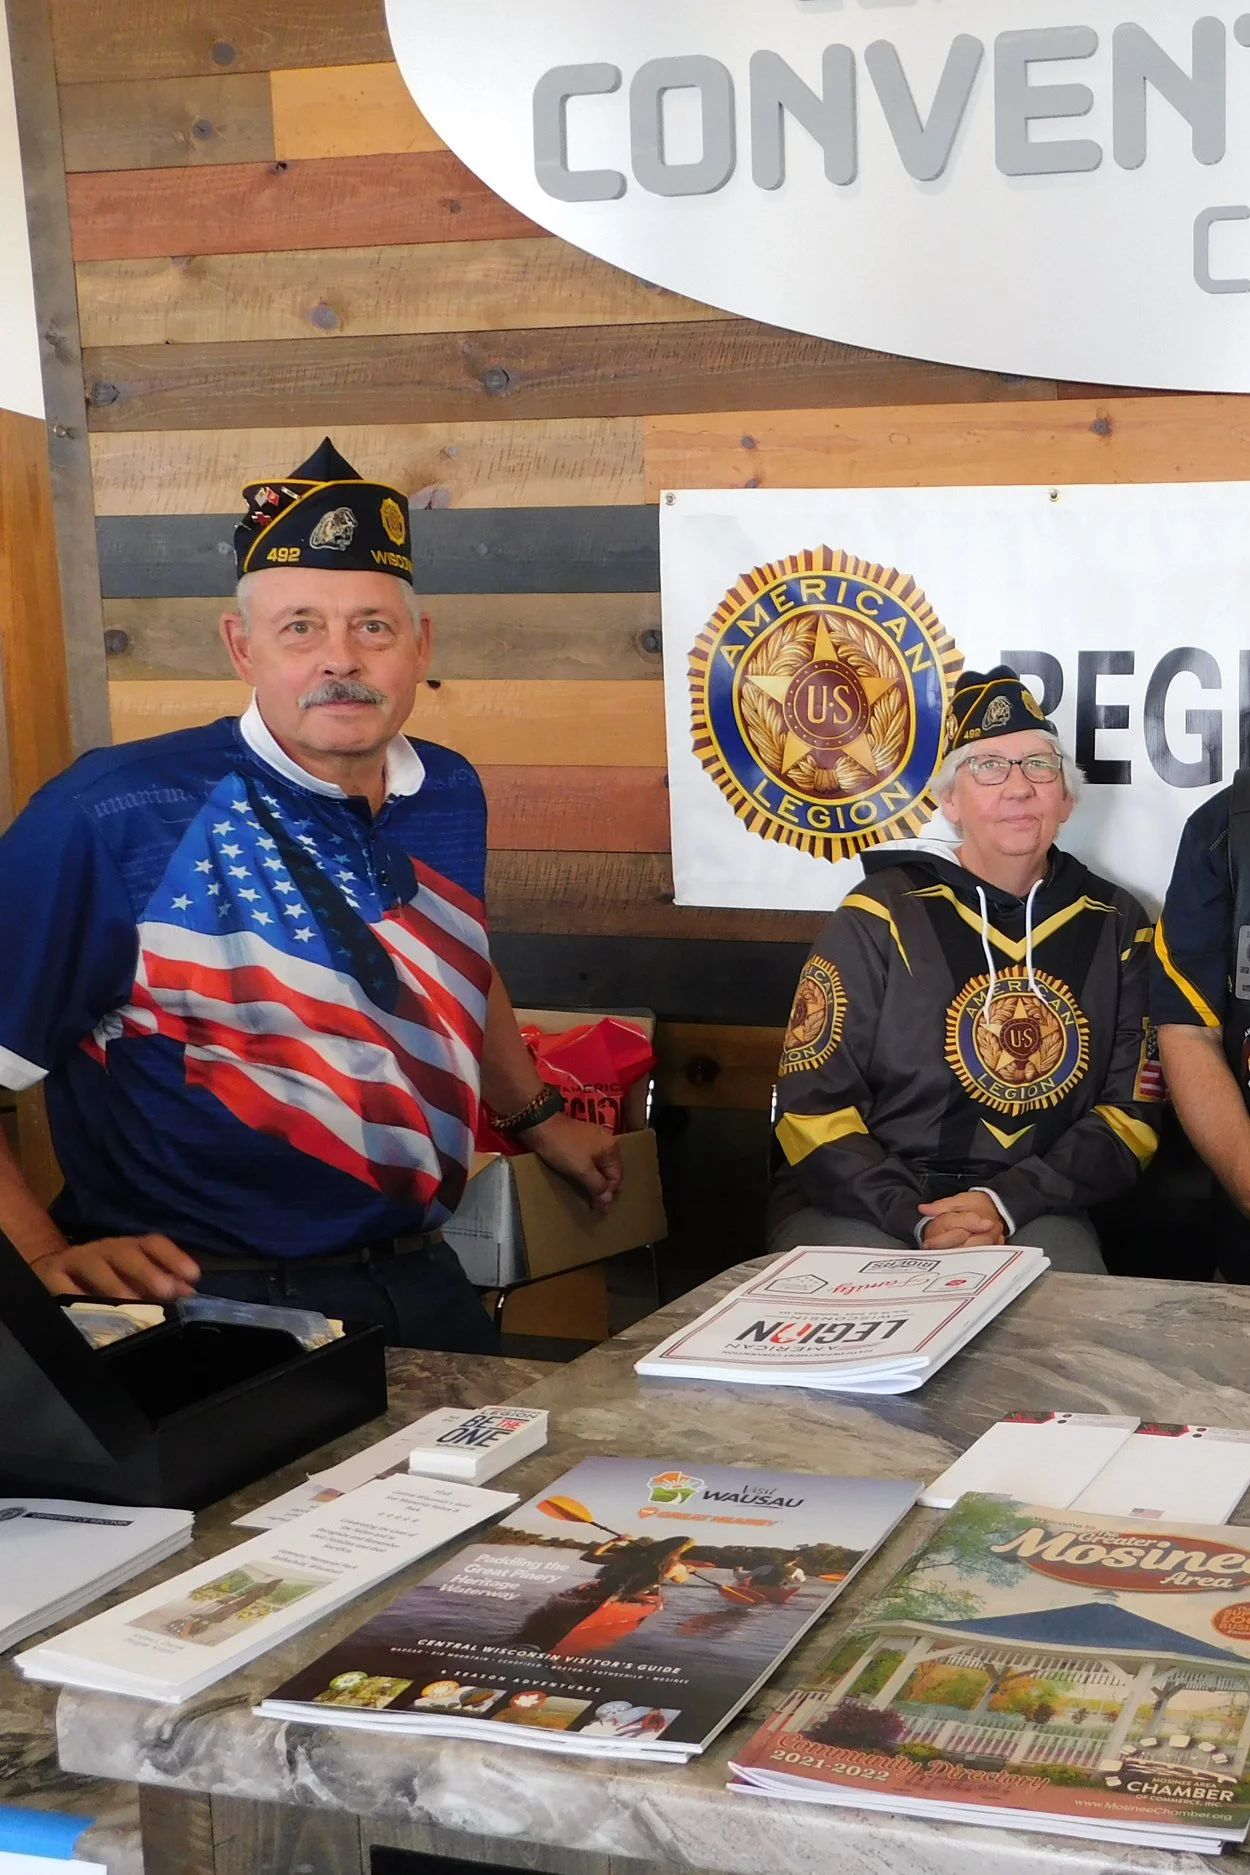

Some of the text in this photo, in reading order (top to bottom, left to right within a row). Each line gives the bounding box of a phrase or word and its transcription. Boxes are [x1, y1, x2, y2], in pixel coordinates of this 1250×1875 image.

[266, 547, 301, 563] 492
[720, 579, 932, 673] AMERICAN
[963, 728, 981, 740] 492
[753, 780, 912, 829] LEGION
[977, 1073, 1056, 1099] LEGION
[735, 1318, 909, 1344] LEGION
[724, 1343, 840, 1352] AMERICAN
[459, 1414, 502, 1428] BE
[495, 1417, 526, 1430] THE
[436, 1427, 511, 1447] ONE
[742, 1485, 778, 1496] Visit
[702, 1491, 804, 1508] WAUSAU
[1077, 1532, 1158, 1548] Greater
[475, 1554, 571, 1571] Paddling the
[450, 1574, 521, 1590] Heritage
[464, 1563, 563, 1584] Great Pinery
[1160, 1571, 1234, 1588] Area
[439, 1584, 521, 1600] Waterway
[417, 1639, 682, 1674] CENTRAL WISCONSIN VISITOR'S GUIDE
[454, 1670, 507, 1681] SEASON
[512, 1678, 601, 1693] ADVENTURES
[770, 1750, 890, 1782] 2021-2022
[776, 1733, 1050, 1793] Community Directory
[1152, 1777, 1193, 1786] MOSINEE
[1127, 1781, 1235, 1802] CHAMBER
[1150, 1795, 1203, 1806] COMMERCE,
[1074, 1799, 1233, 1822] www.MosineeChamber.org
